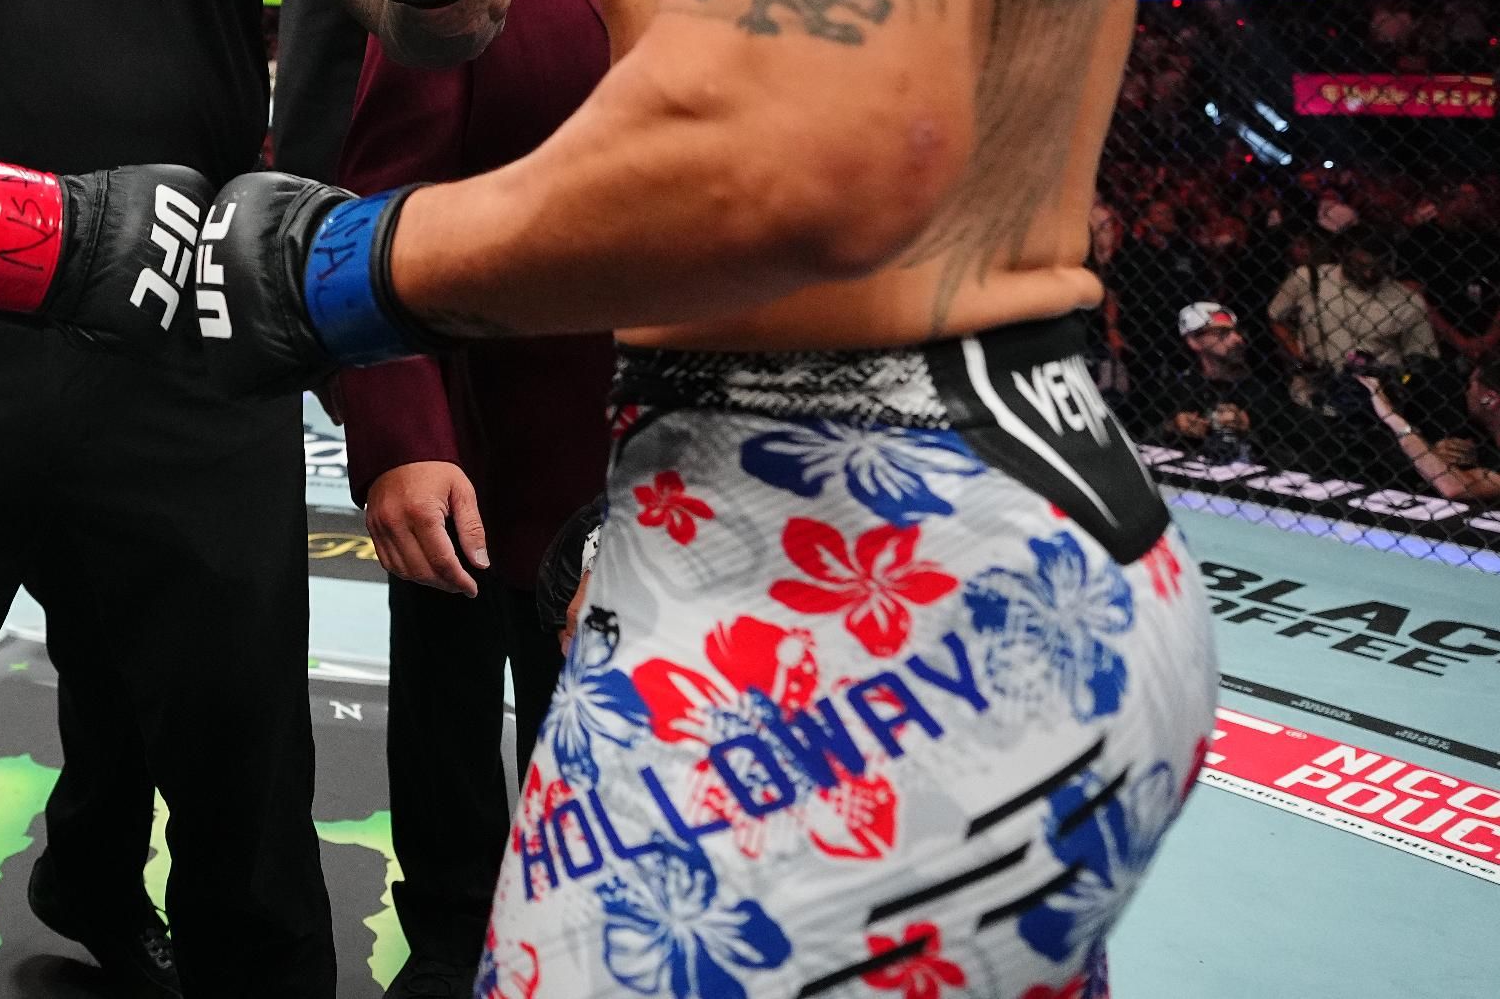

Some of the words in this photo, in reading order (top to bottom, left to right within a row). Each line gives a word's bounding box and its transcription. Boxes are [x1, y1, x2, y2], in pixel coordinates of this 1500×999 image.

[129, 184, 200, 331] UFC
[195, 203, 237, 339] UFC
[1199, 561, 1500, 664] BLAC
[522, 632, 990, 901] HOLLOWAY
[1206, 773, 1299, 808] Nicotine
[1306, 806, 1326, 817] is
[1334, 816, 1364, 829] an
[1371, 829, 1497, 876] addictive
[1273, 764, 1500, 860] POUC
